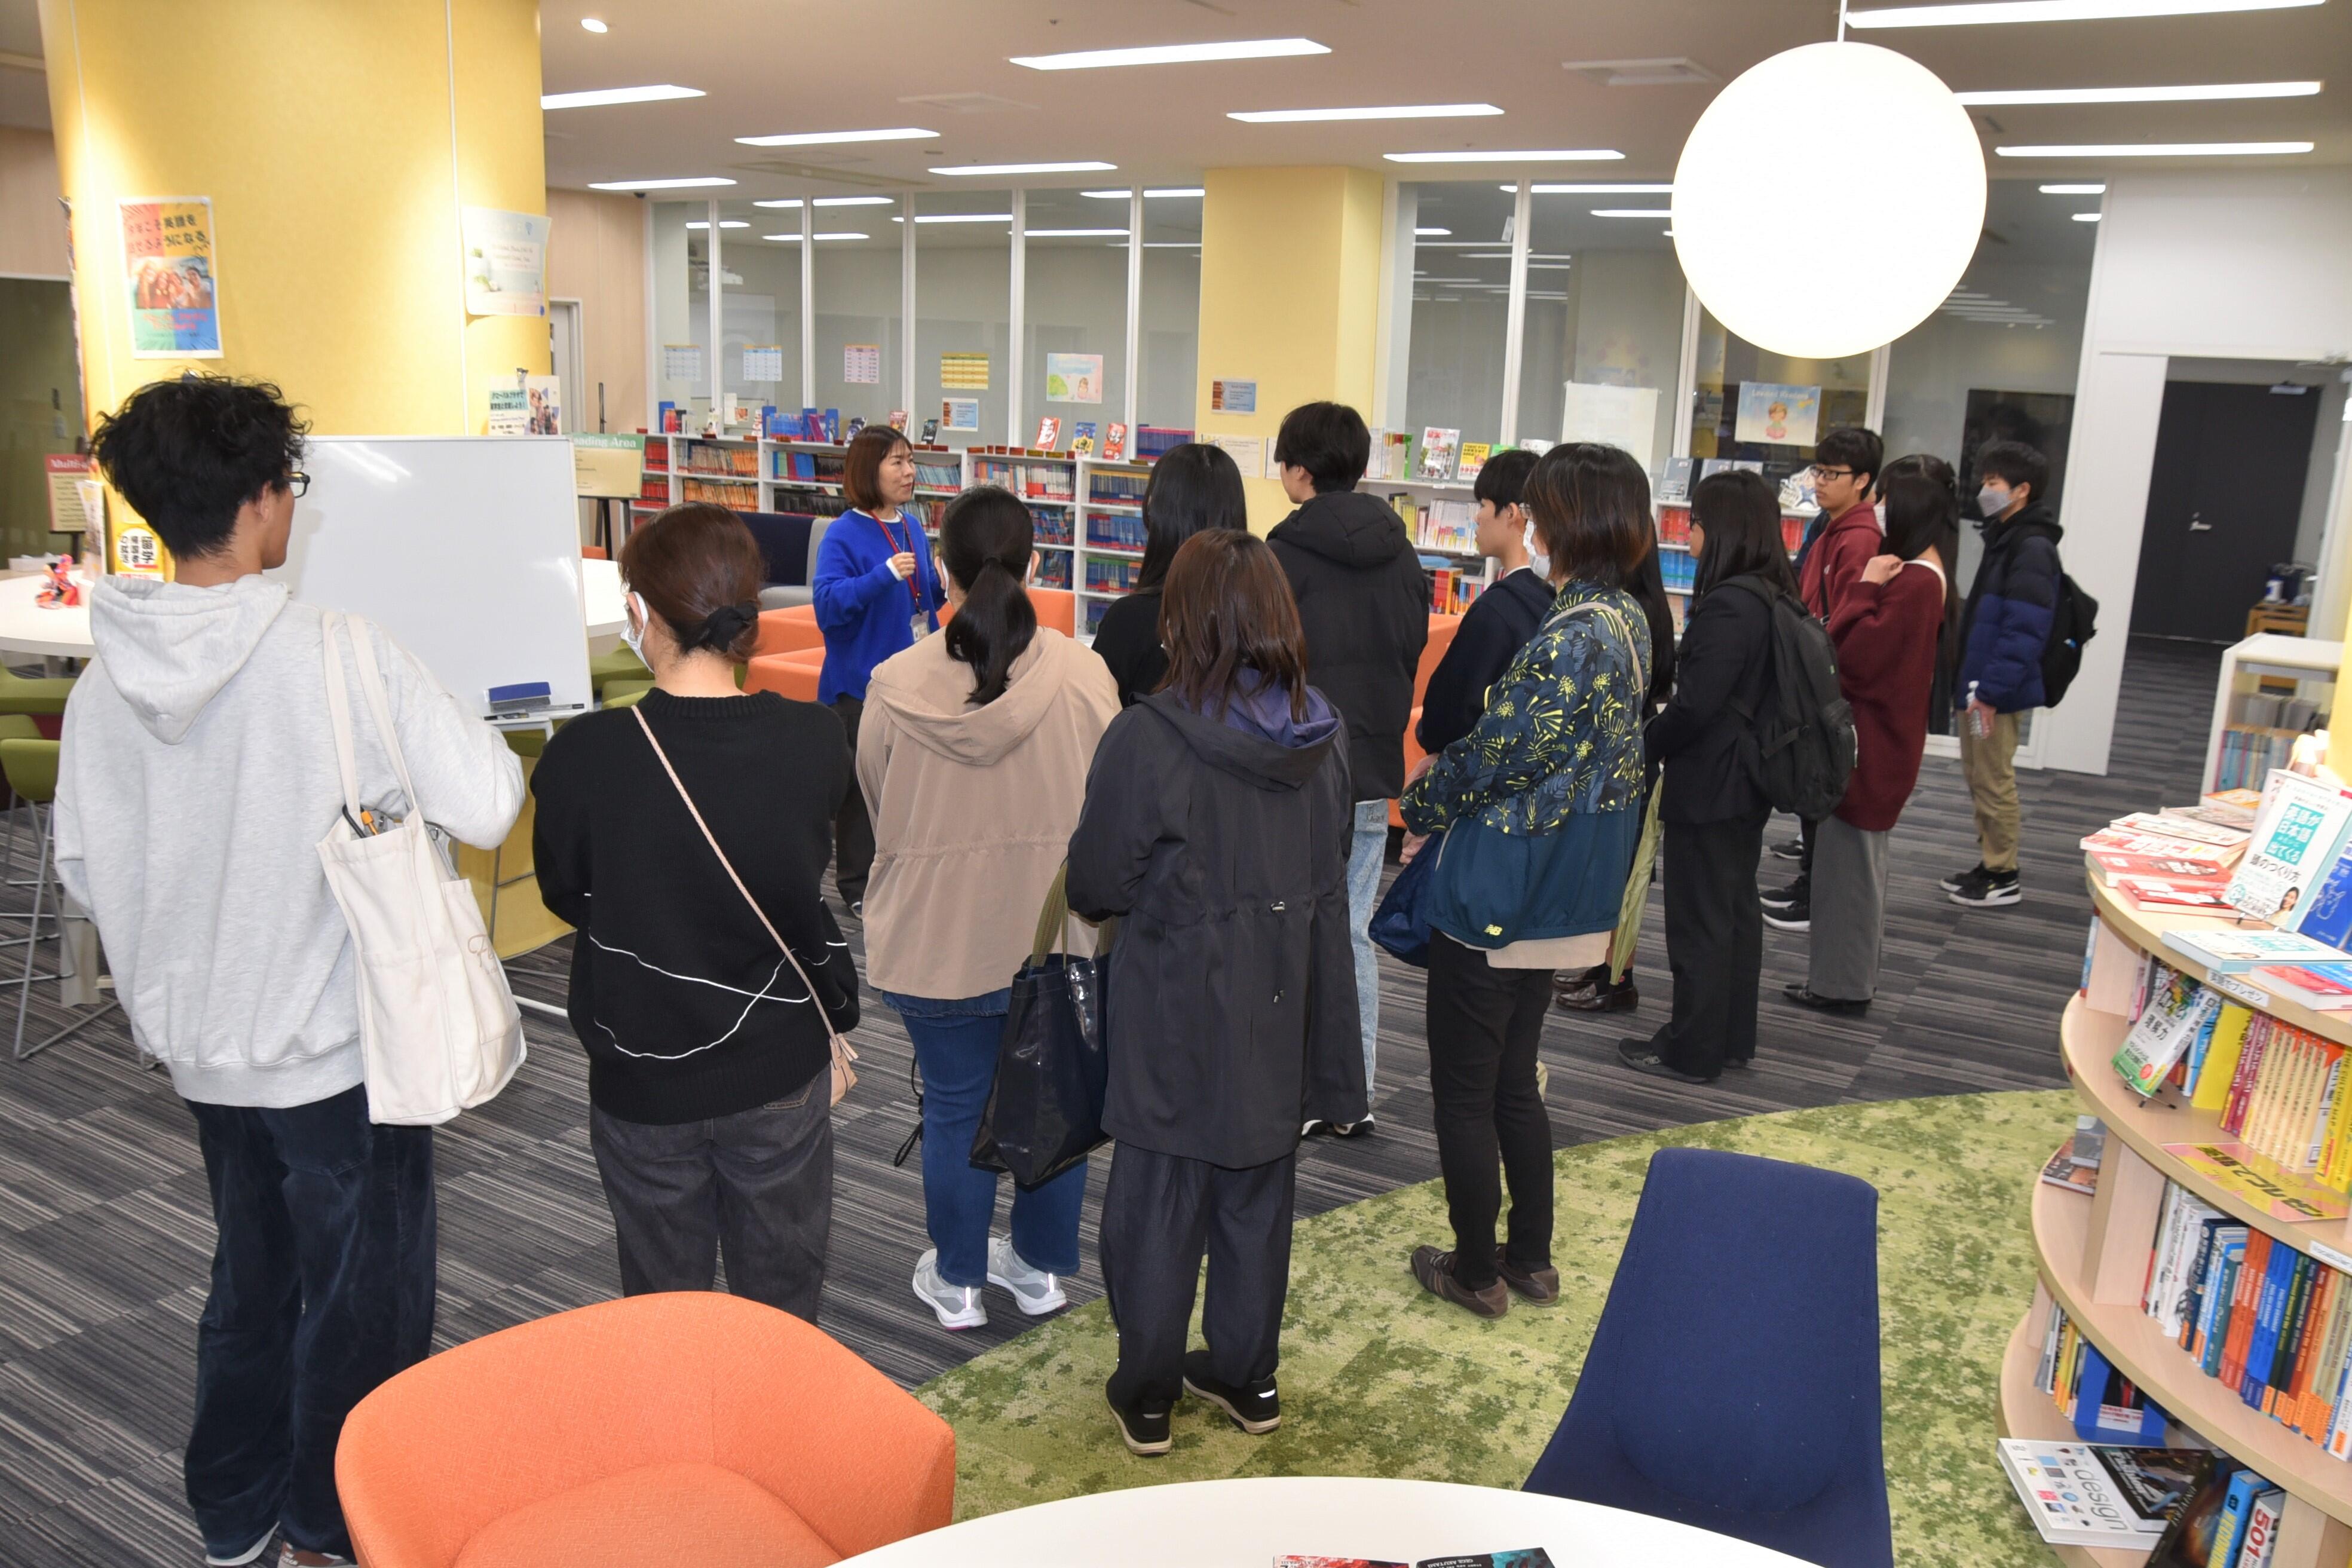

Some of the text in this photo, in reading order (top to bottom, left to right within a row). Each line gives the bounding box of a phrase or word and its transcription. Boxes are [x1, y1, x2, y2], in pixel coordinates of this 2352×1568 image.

[574, 437, 636, 449] eading Area
[2284, 806, 2323, 826] 英語が
[2277, 822, 2314, 843] 日本語
[2267, 841, 2301, 863] 出てくる
[2249, 853, 2301, 883] 頭のつくり方
[2330, 1108, 2341, 1126] MAP
[2075, 1469, 2128, 1530] design
[2246, 1508, 2271, 1558] 501
